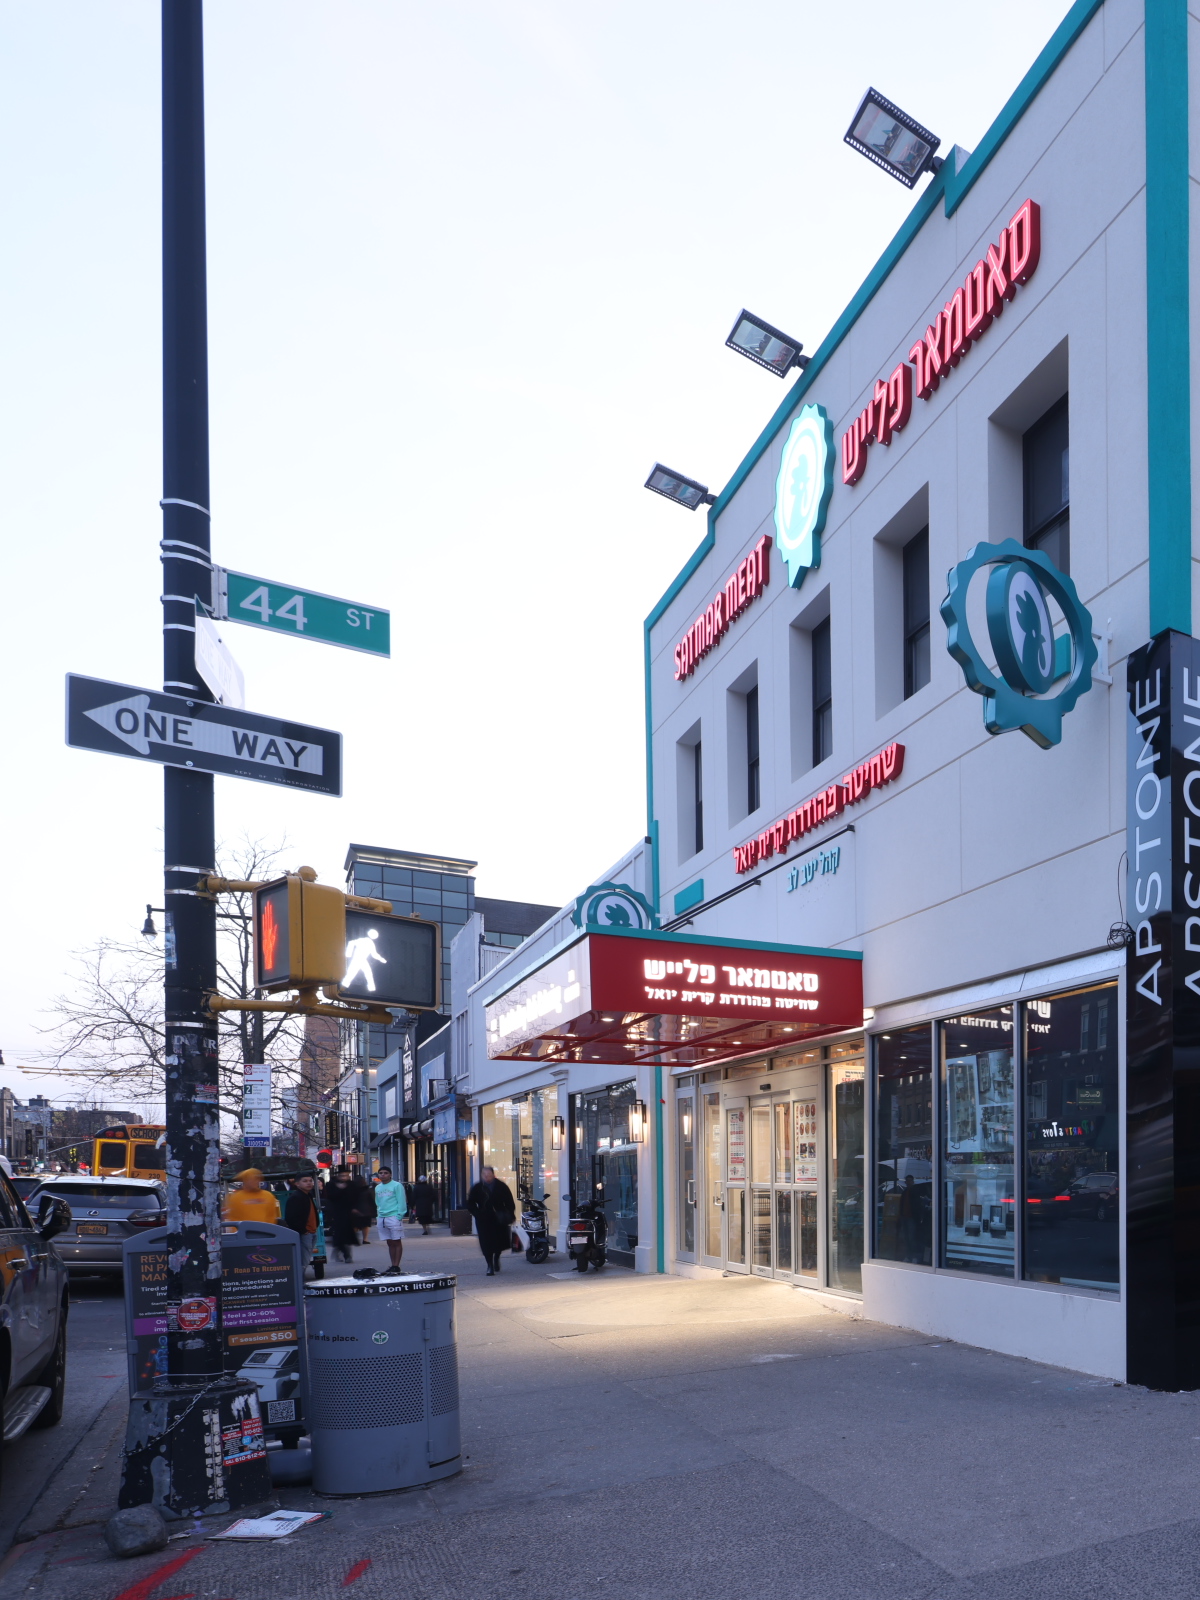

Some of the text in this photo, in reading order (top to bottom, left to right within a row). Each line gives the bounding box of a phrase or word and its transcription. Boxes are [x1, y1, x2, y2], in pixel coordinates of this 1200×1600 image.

[841, 198, 1041, 487] סאטמאר פלייש
[240, 586, 374, 630] 44 ST
[674, 534, 772, 681] SATMAR MEAT
[115, 708, 308, 768] ONE WAY
[274, 778, 330, 792] TRANSPORTATION
[1135, 667, 1162, 1006] APSTONE
[732, 839, 758, 874] יואל
[786, 866, 799, 893] לב
[644, 959, 819, 992] סאטמאר פלייש
[644, 986, 678, 1000] יואל
[246, 1110, 251, 1118] 4
[379, 1284, 409, 1293] Don't
[270, 1332, 292, 1340] $50
